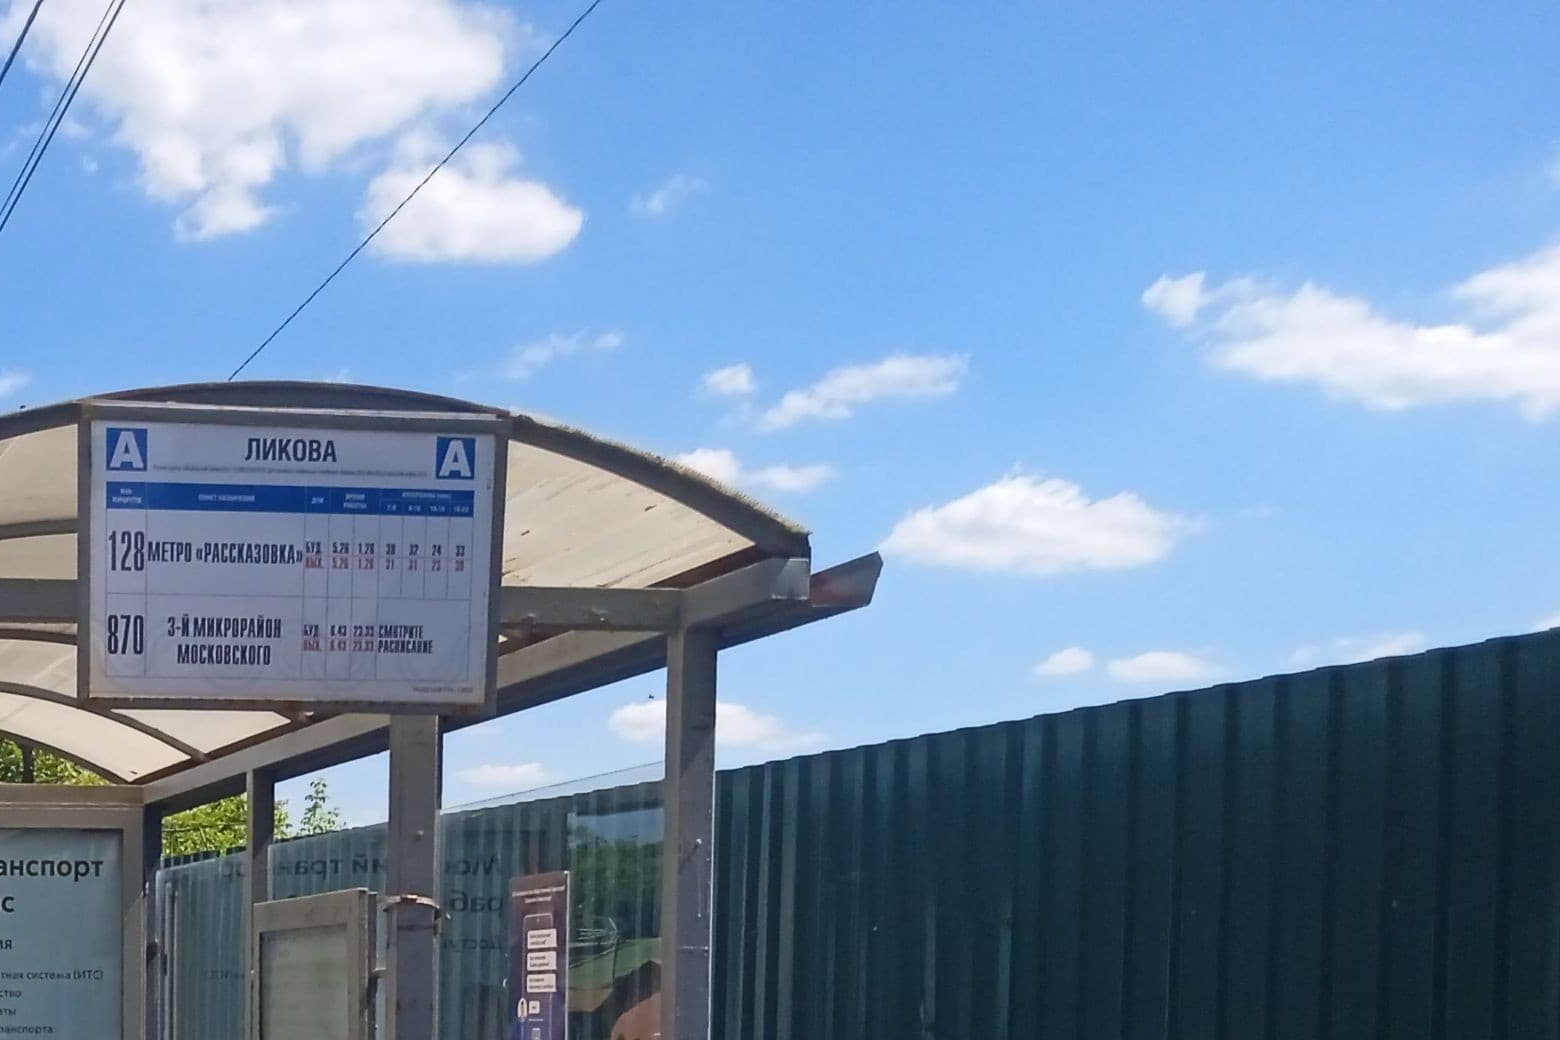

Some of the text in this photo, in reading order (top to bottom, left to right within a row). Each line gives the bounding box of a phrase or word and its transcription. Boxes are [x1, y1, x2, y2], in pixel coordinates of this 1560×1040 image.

[244, 437, 338, 463] ЛИКОВА
[108, 530, 145, 571] 128
[147, 541, 303, 565] МЕТРО «РАССКАЗОВКА»
[107, 613, 144, 656] 870
[167, 613, 282, 639] 3-Й МИКРОРАЙОН
[378, 625, 424, 639] СМОТРИТЕ
[176, 643, 272, 666] МОСКОВСКОГО
[377, 639, 433, 654] РАСПИСАНИЕ
[26, 971, 71, 980] система
